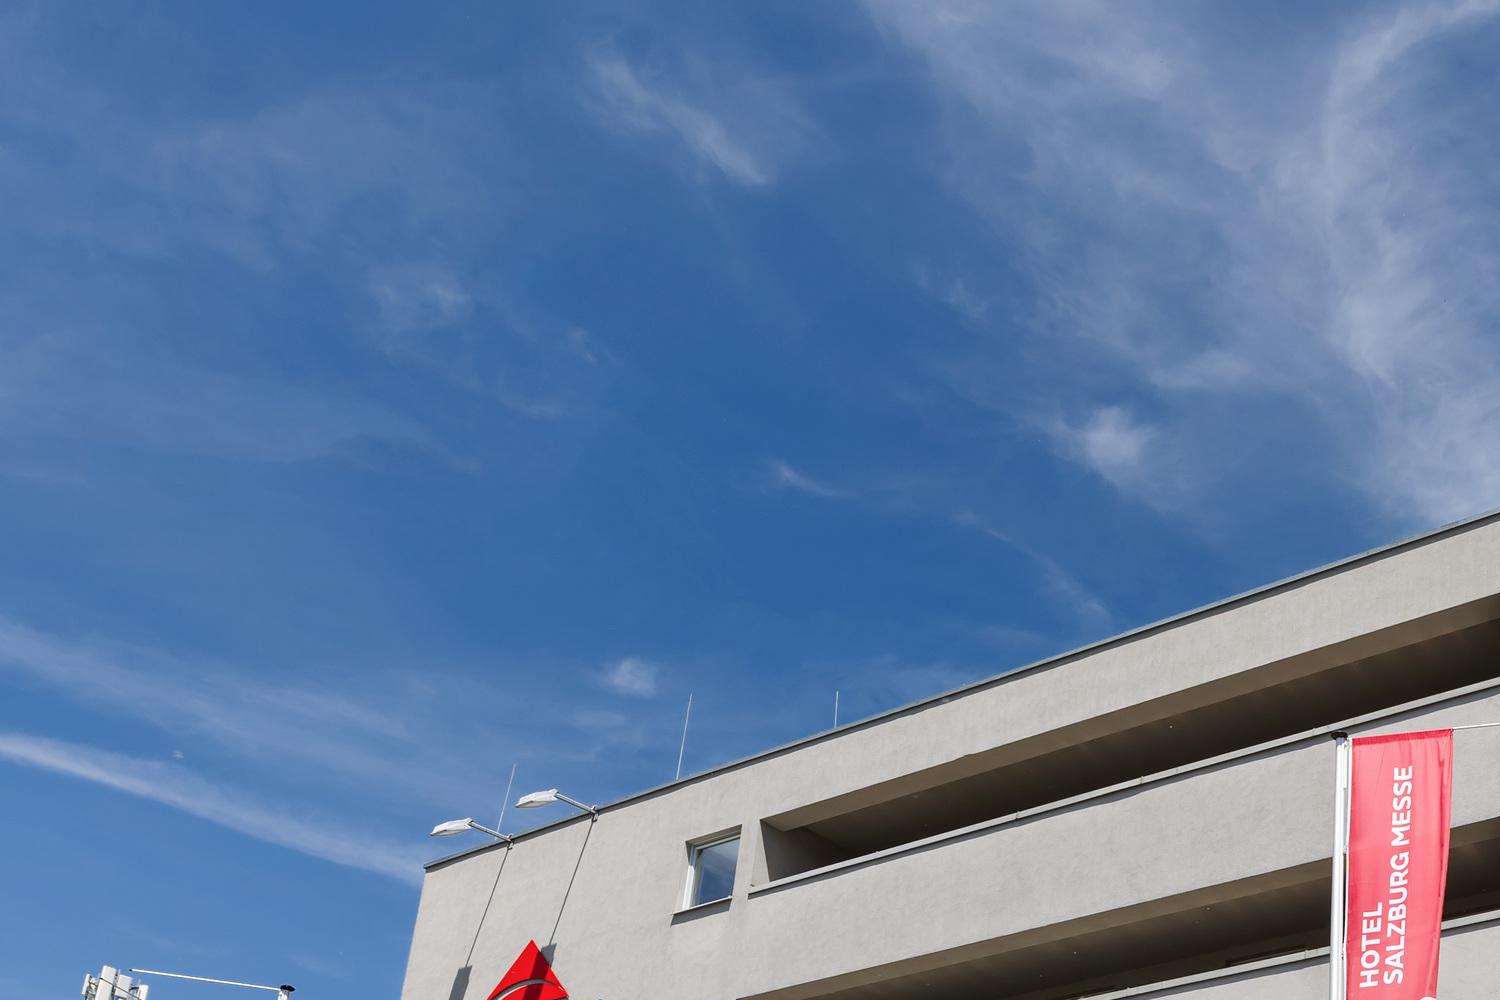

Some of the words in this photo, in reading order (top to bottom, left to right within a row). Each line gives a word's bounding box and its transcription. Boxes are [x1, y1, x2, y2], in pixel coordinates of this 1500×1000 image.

[1391, 766, 1412, 846] MESSE
[1360, 902, 1382, 987] HOTEL
[1383, 851, 1409, 984] SALZBURG
